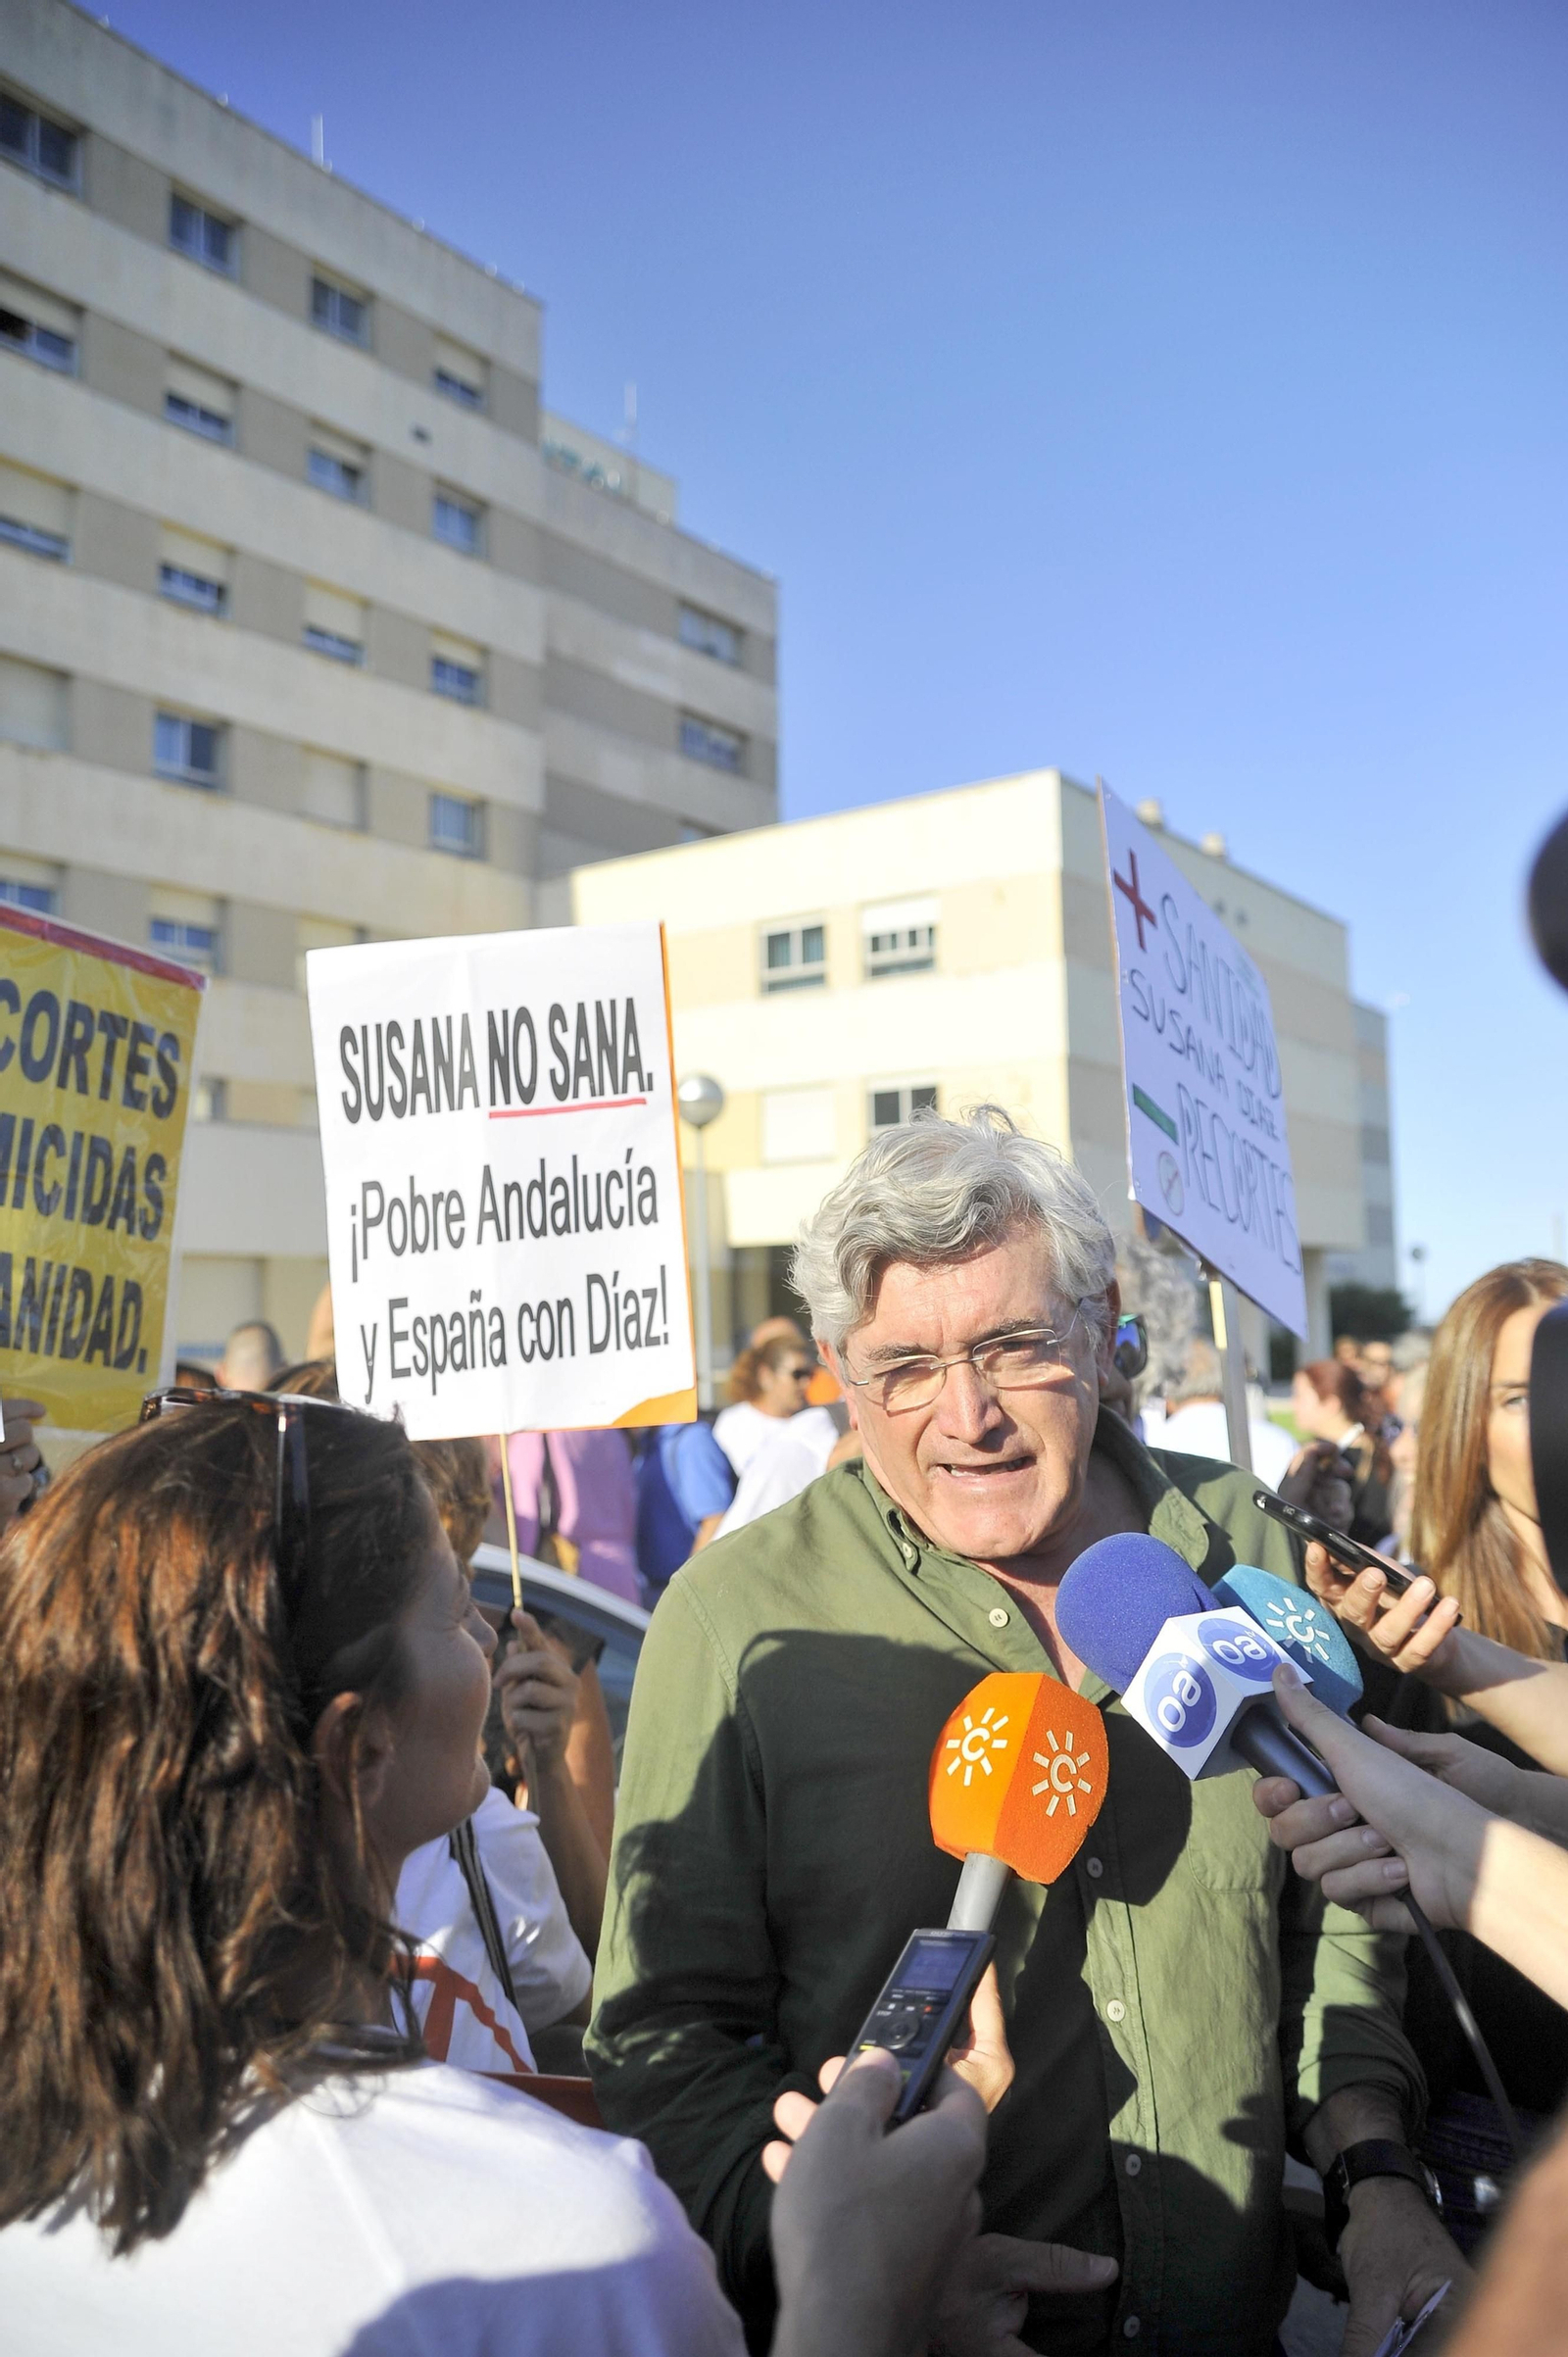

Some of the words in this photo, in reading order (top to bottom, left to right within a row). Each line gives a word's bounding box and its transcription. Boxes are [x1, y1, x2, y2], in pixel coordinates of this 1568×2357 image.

[340, 1013, 480, 1124] SUSANA
[487, 1006, 538, 1106] NO
[549, 998, 654, 1102] SANA.
[1129, 968, 1229, 1099] SUSANA
[351, 1176, 466, 1283] ¡Pobre
[476, 1149, 659, 1245] Andalucía
[360, 1322, 378, 1404] y
[388, 1290, 507, 1396] España
[517, 1298, 575, 1364] con
[587, 1265, 669, 1354] Díaz!
